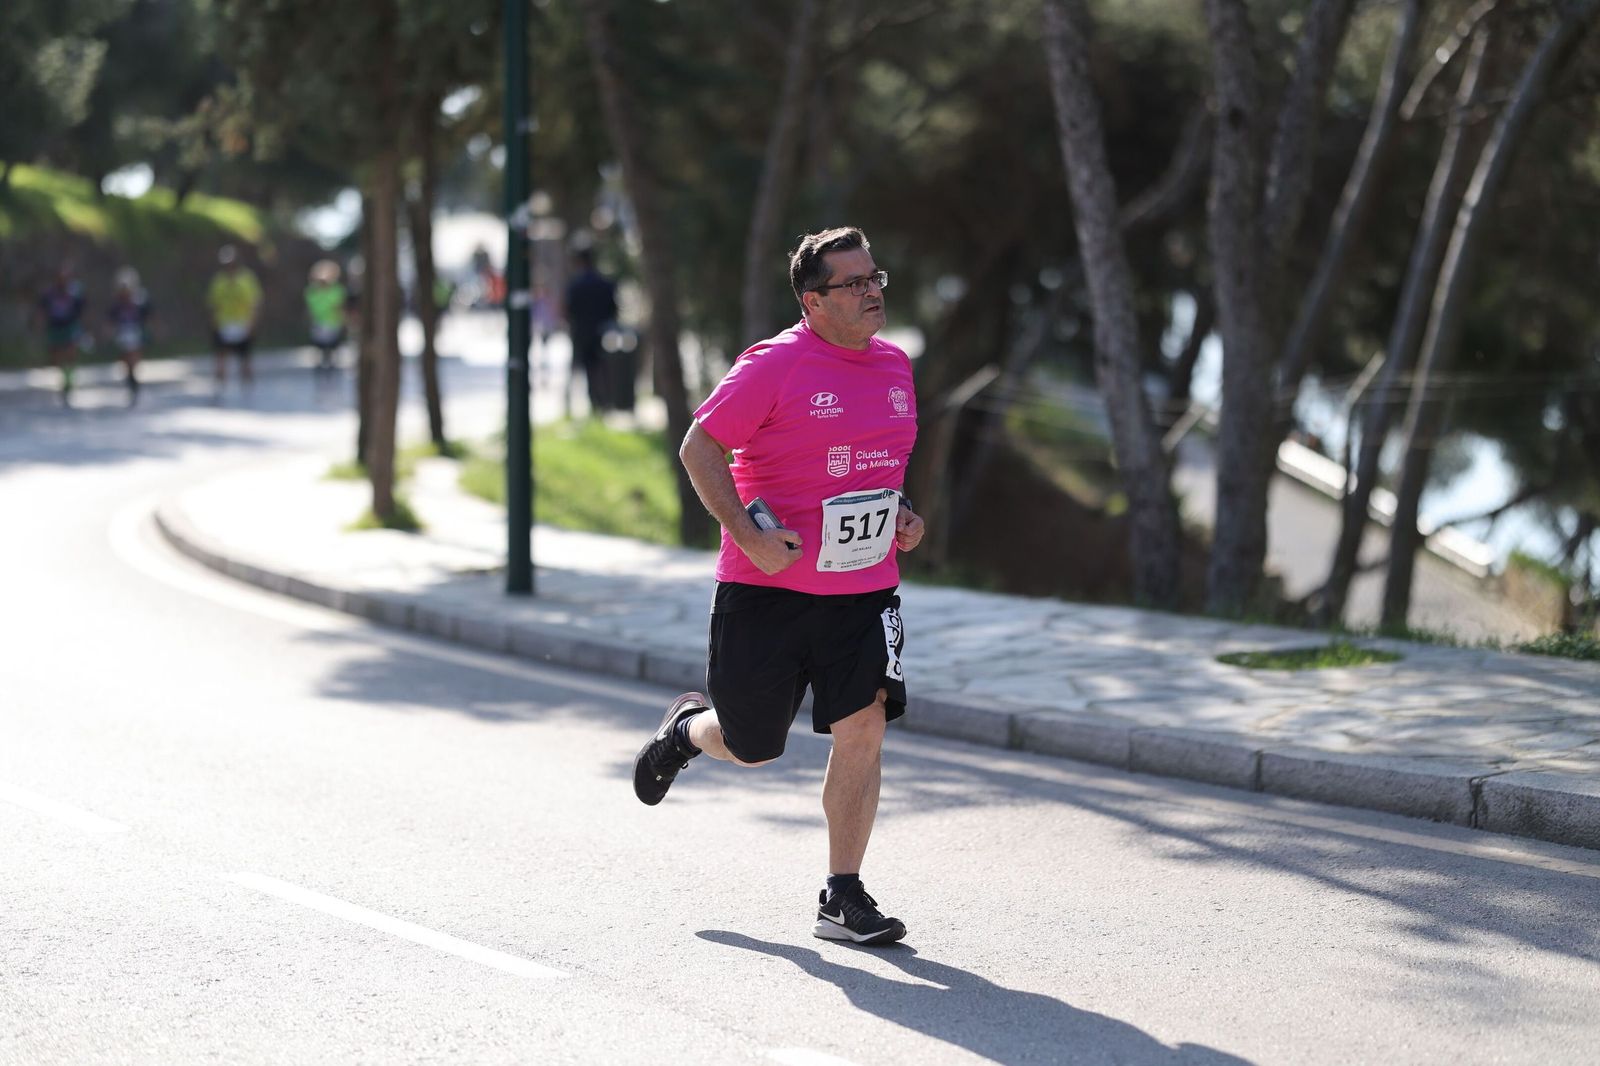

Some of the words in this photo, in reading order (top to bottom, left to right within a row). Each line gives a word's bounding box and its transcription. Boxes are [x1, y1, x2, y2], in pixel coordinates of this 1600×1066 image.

[810, 407, 844, 416] HYUNDAI
[855, 449, 888, 460] Ciudad
[855, 462, 868, 470] de
[838, 508, 890, 544] 517
